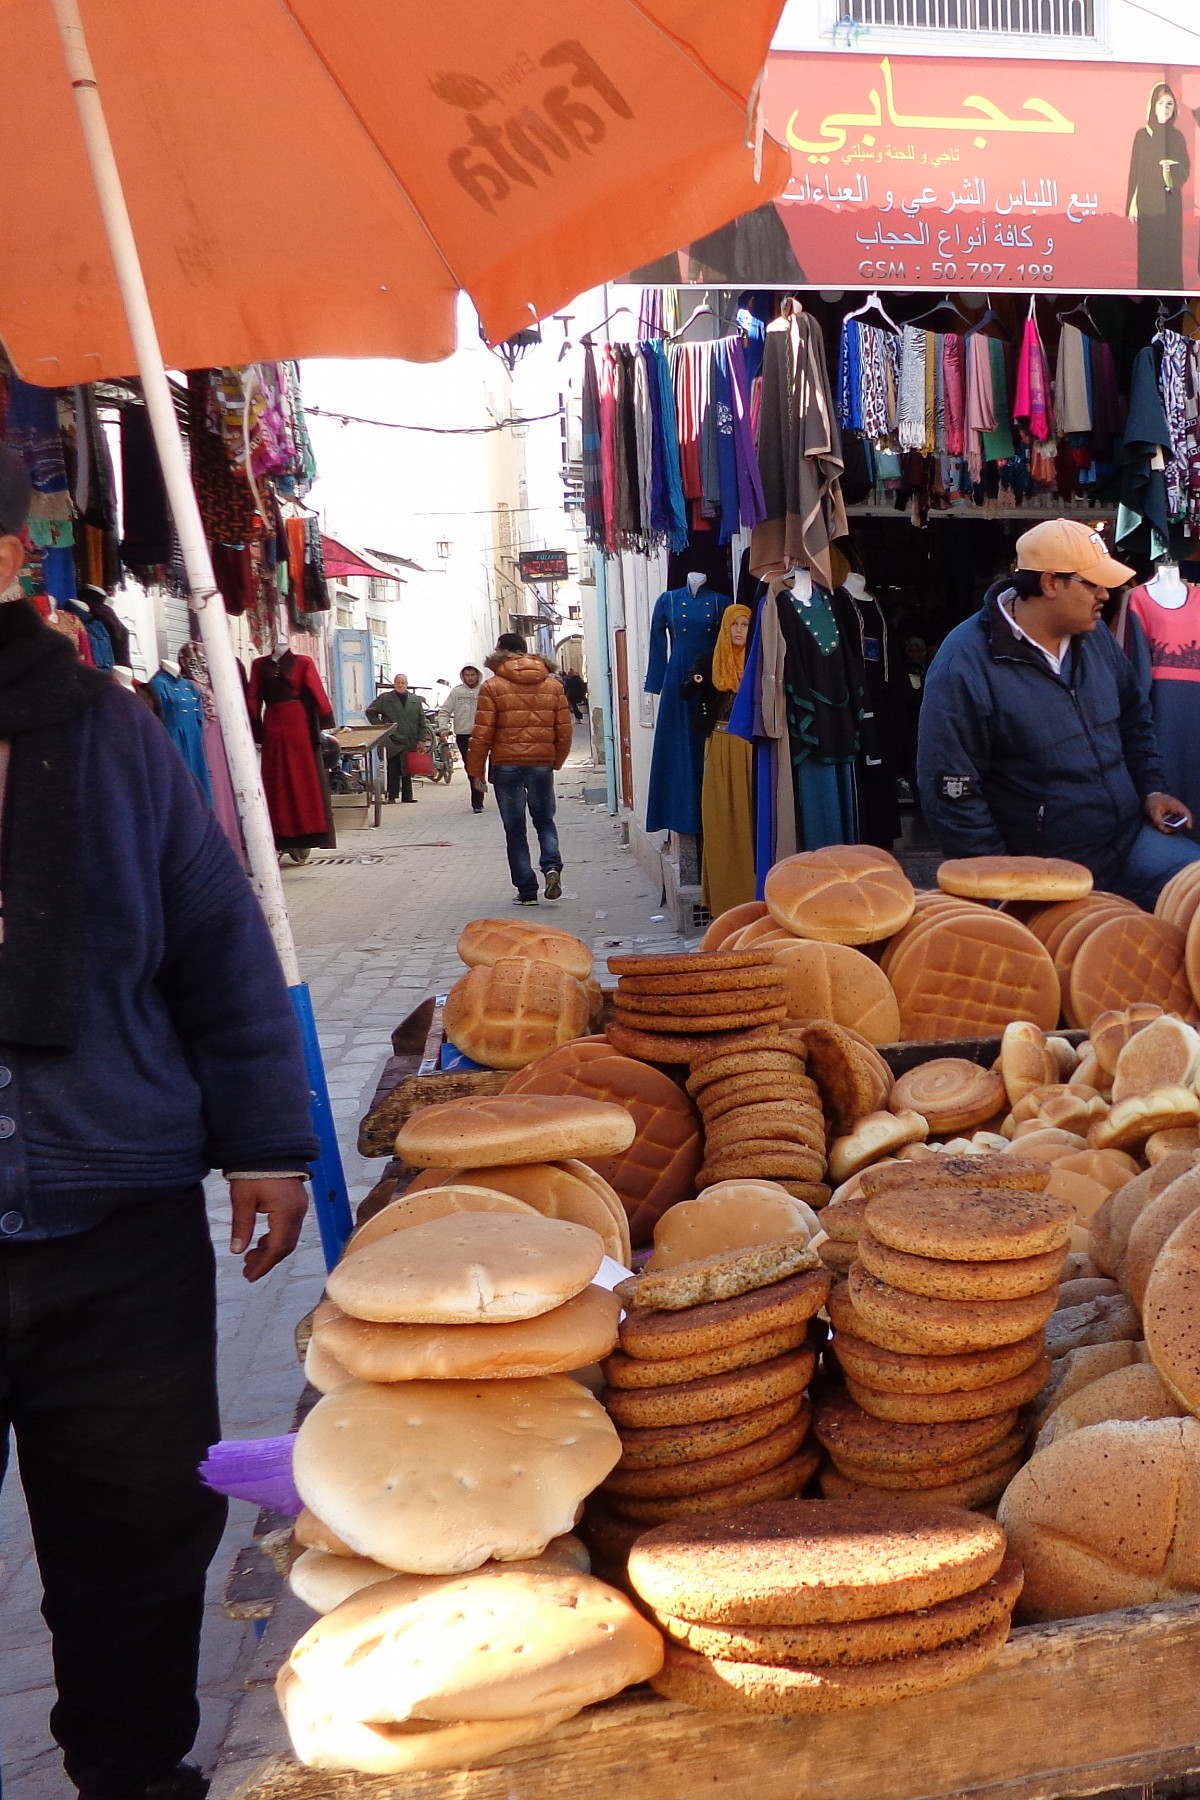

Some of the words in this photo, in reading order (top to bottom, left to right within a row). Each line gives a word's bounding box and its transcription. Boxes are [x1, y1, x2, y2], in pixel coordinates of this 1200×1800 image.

[785, 56, 1075, 165] حجابي
[931, 147, 960, 168] تاجي
[781, 173, 869, 210] العباءات
[880, 191, 894, 212] و
[996, 177, 1058, 214] اللباس
[1067, 191, 1099, 223] بيع
[856, 221, 930, 250] الحجاب
[937, 218, 988, 258] أنواع
[994, 222, 1033, 248] كافة
[1041, 234, 1055, 255] و
[858, 261, 906, 279] GSM
[931, 262, 1055, 282] 50.797.198
